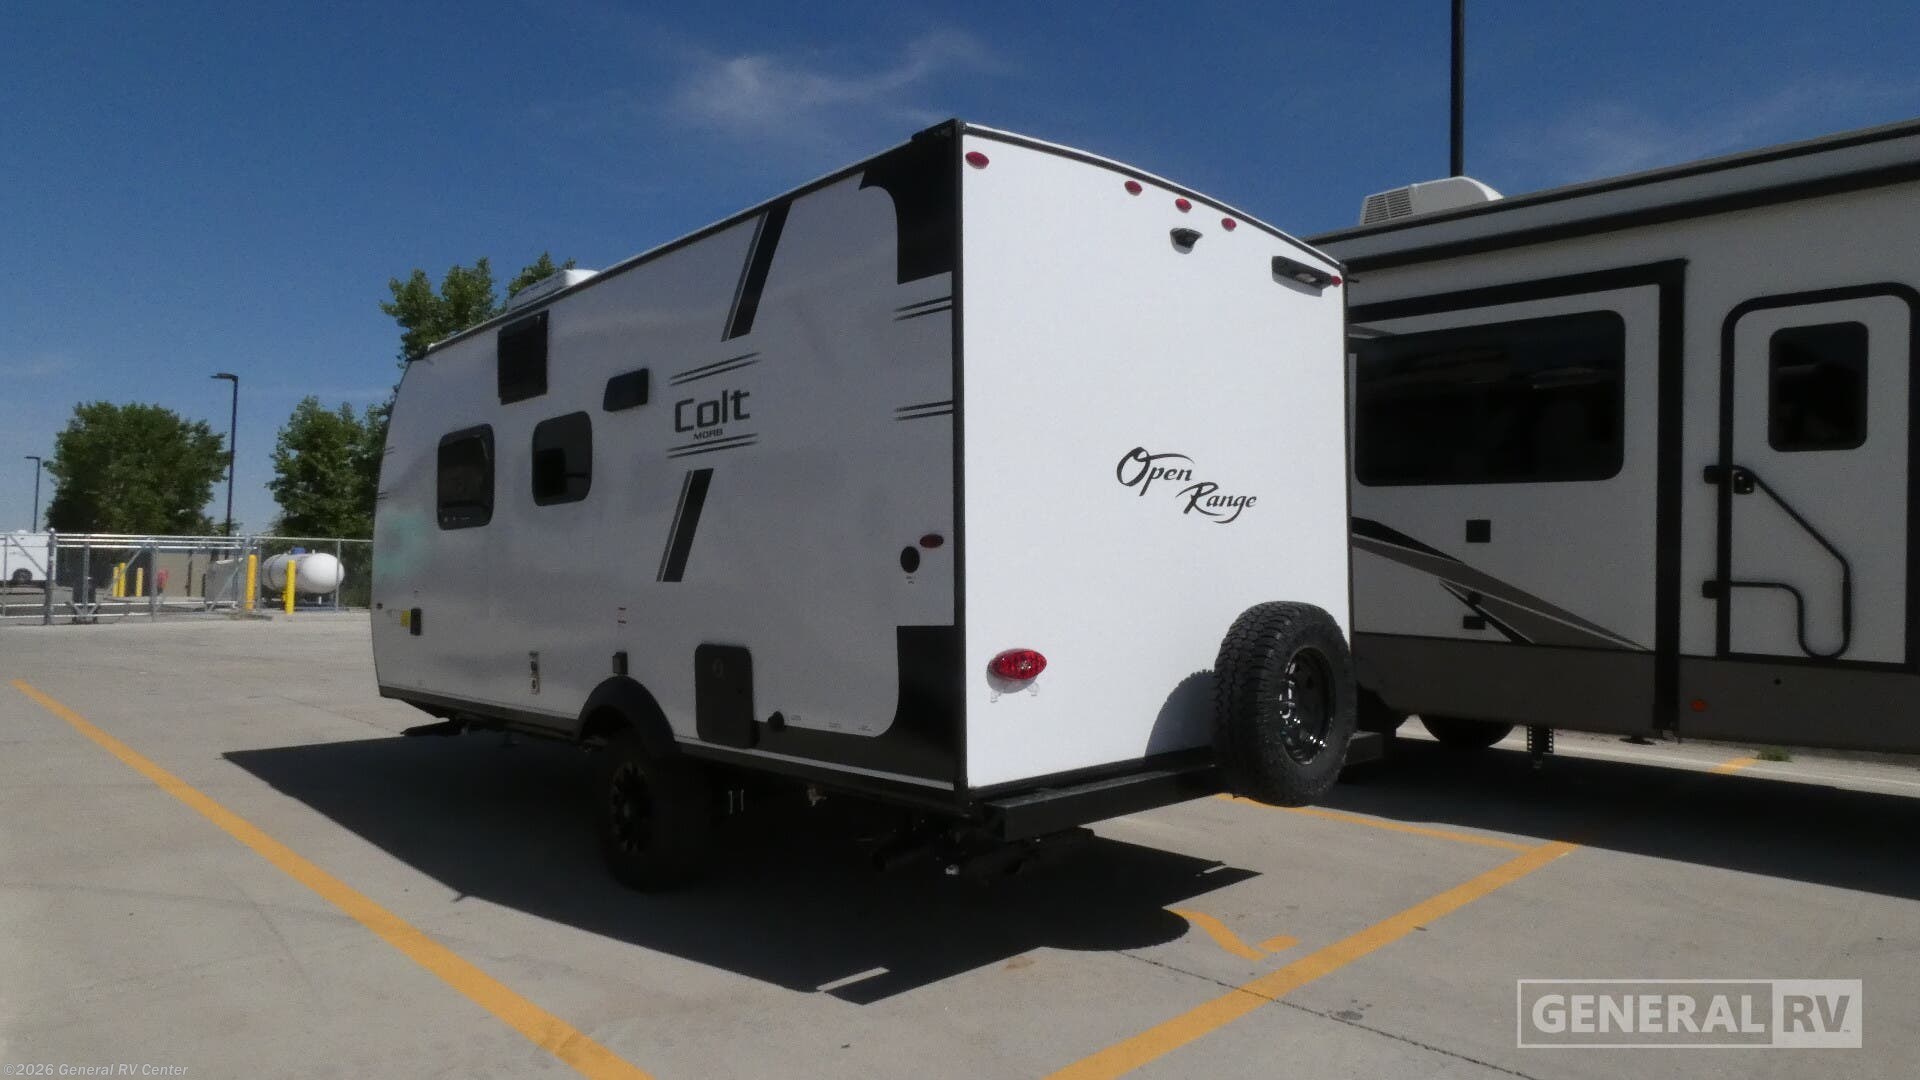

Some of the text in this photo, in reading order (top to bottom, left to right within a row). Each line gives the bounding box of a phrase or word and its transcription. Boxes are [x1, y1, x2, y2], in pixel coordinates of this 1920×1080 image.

[675, 389, 750, 433] Colt
[1116, 446, 1195, 496] Open
[1175, 482, 1257, 524] Range
